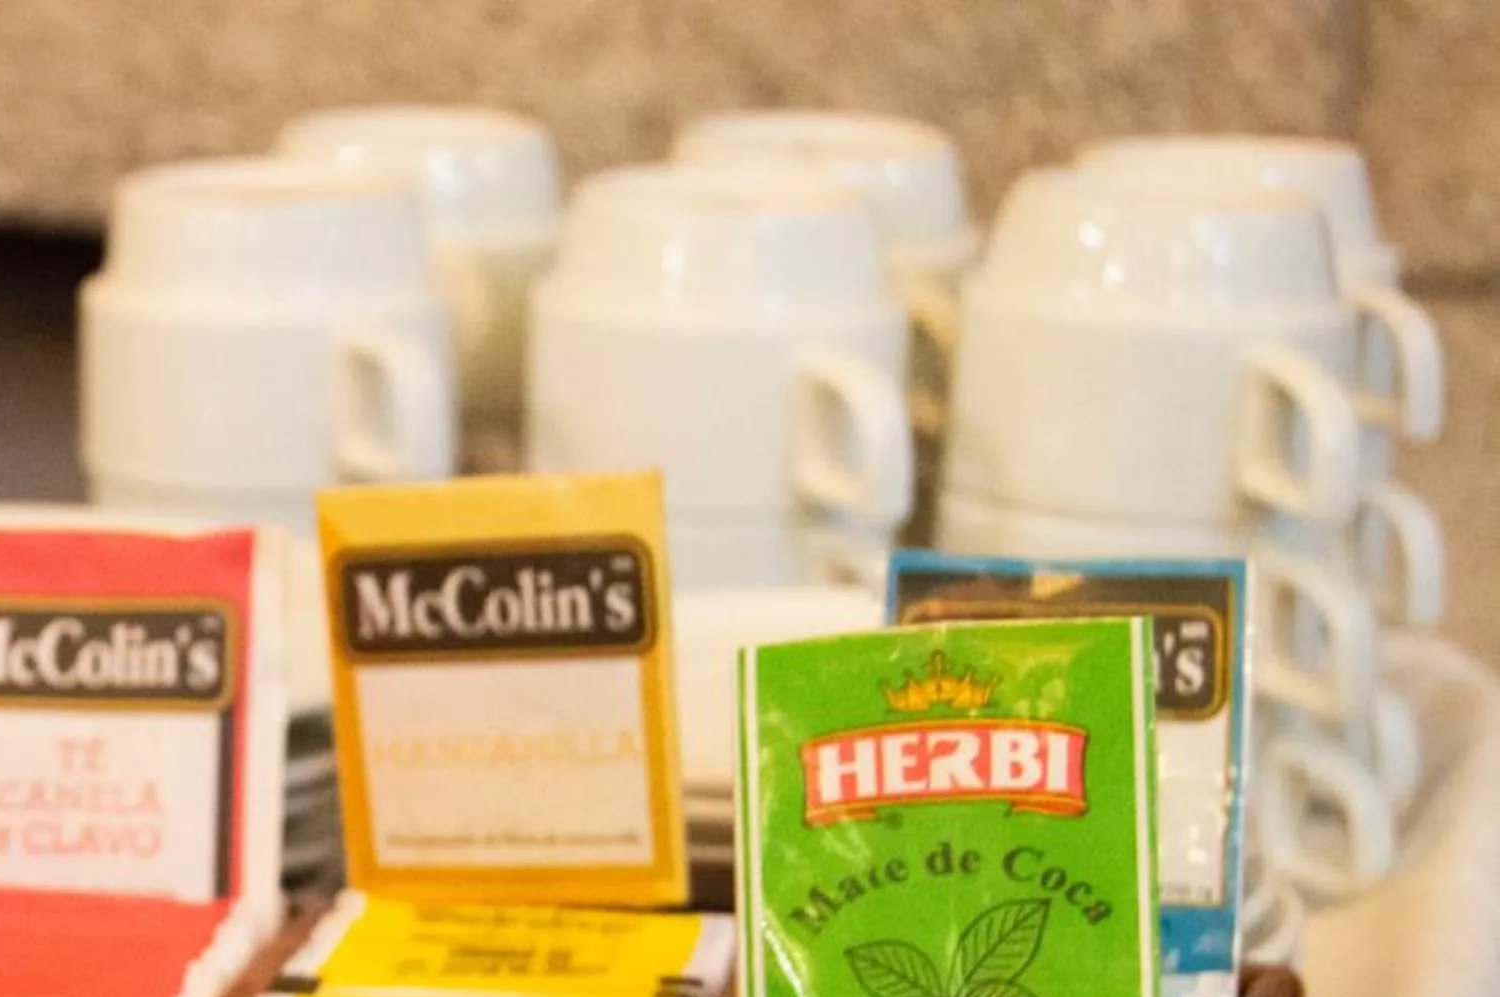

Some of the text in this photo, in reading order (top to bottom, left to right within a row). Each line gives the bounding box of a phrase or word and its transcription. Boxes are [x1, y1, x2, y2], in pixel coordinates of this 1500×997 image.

[353, 565, 636, 640] McColin's
[818, 730, 1071, 803] HERBI
[20, 820, 164, 859] CLAVO
[787, 841, 1115, 937] Mate de Coca
